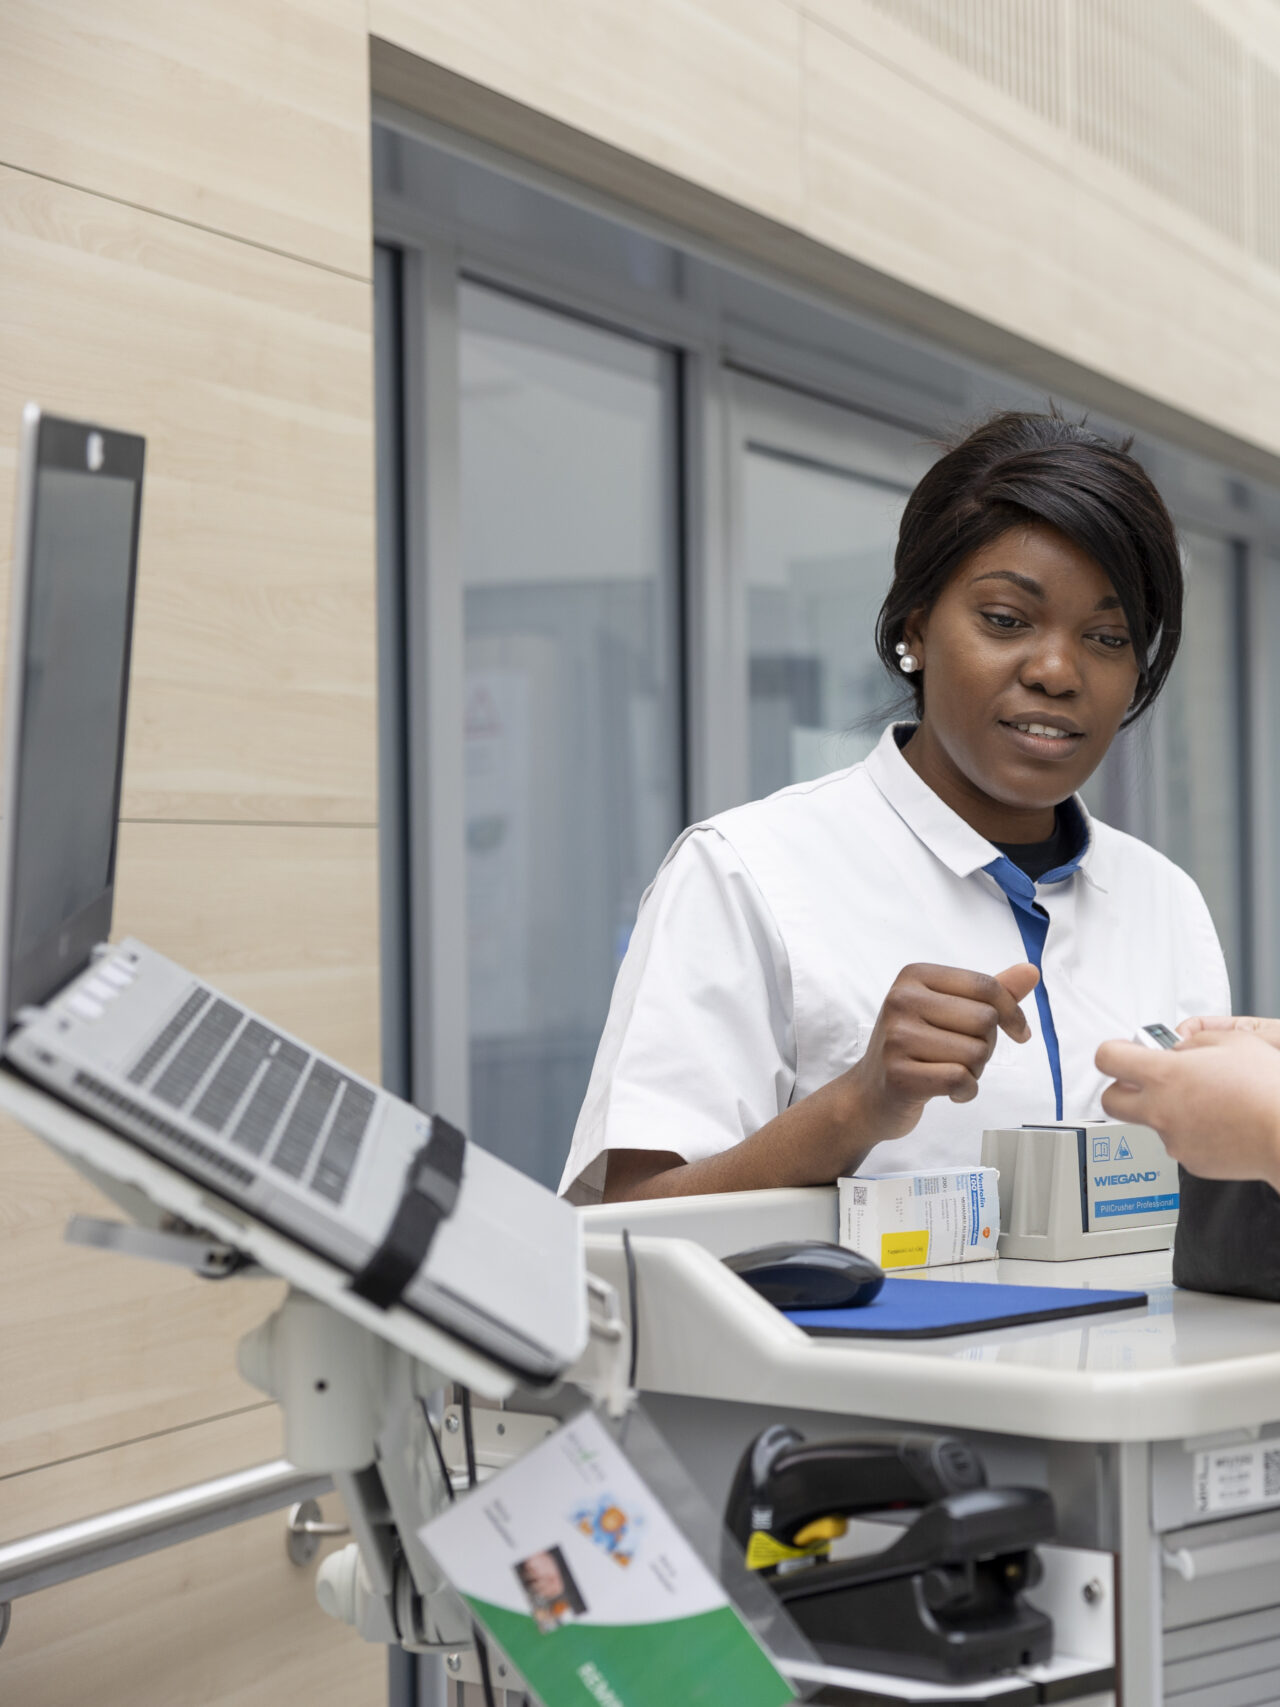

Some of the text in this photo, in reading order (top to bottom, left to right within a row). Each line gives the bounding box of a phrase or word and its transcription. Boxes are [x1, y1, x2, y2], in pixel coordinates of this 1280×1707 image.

[1094, 1171, 1157, 1187] WIEGAND
[1101, 1198, 1174, 1213] PillCrusher Professional
